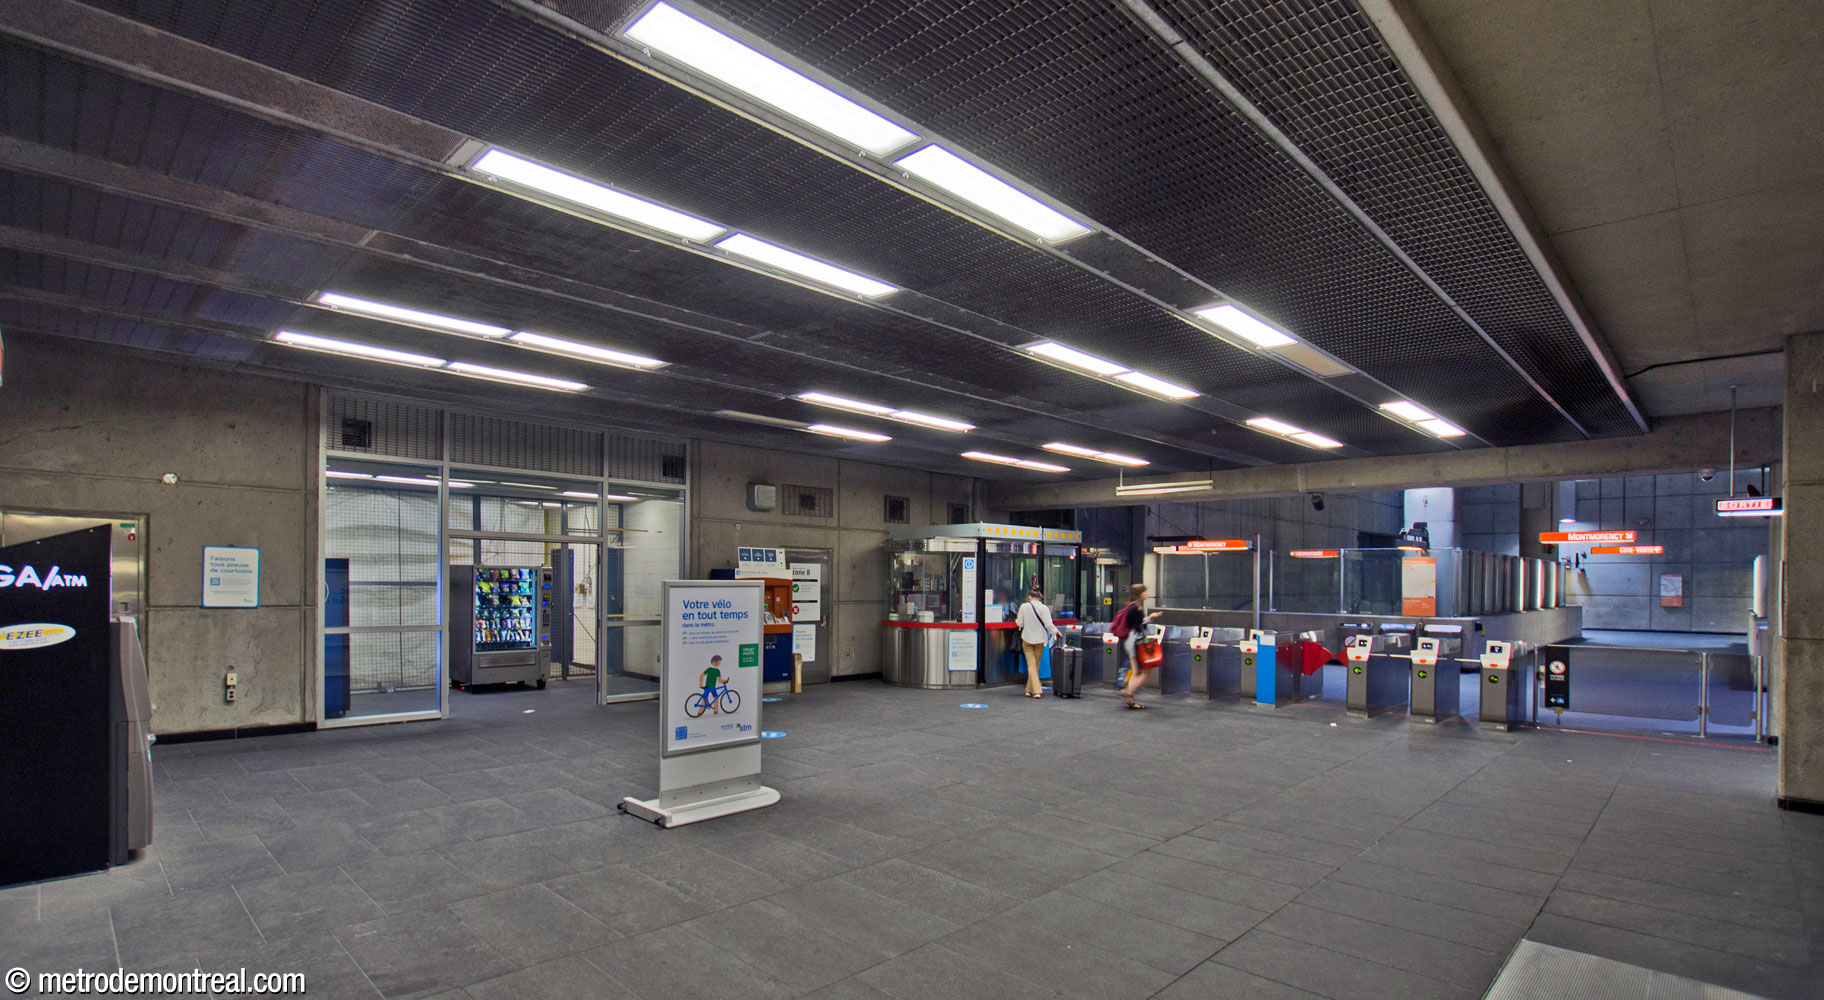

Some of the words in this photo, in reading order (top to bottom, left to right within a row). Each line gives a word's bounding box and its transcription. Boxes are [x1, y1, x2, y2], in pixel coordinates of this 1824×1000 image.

[683, 600, 709, 609] Votre
[712, 599, 732, 608] vélo
[682, 612, 695, 620] en
[697, 611, 717, 620] tout
[720, 611, 749, 621] temps
[6, 629, 43, 640] EZEE
